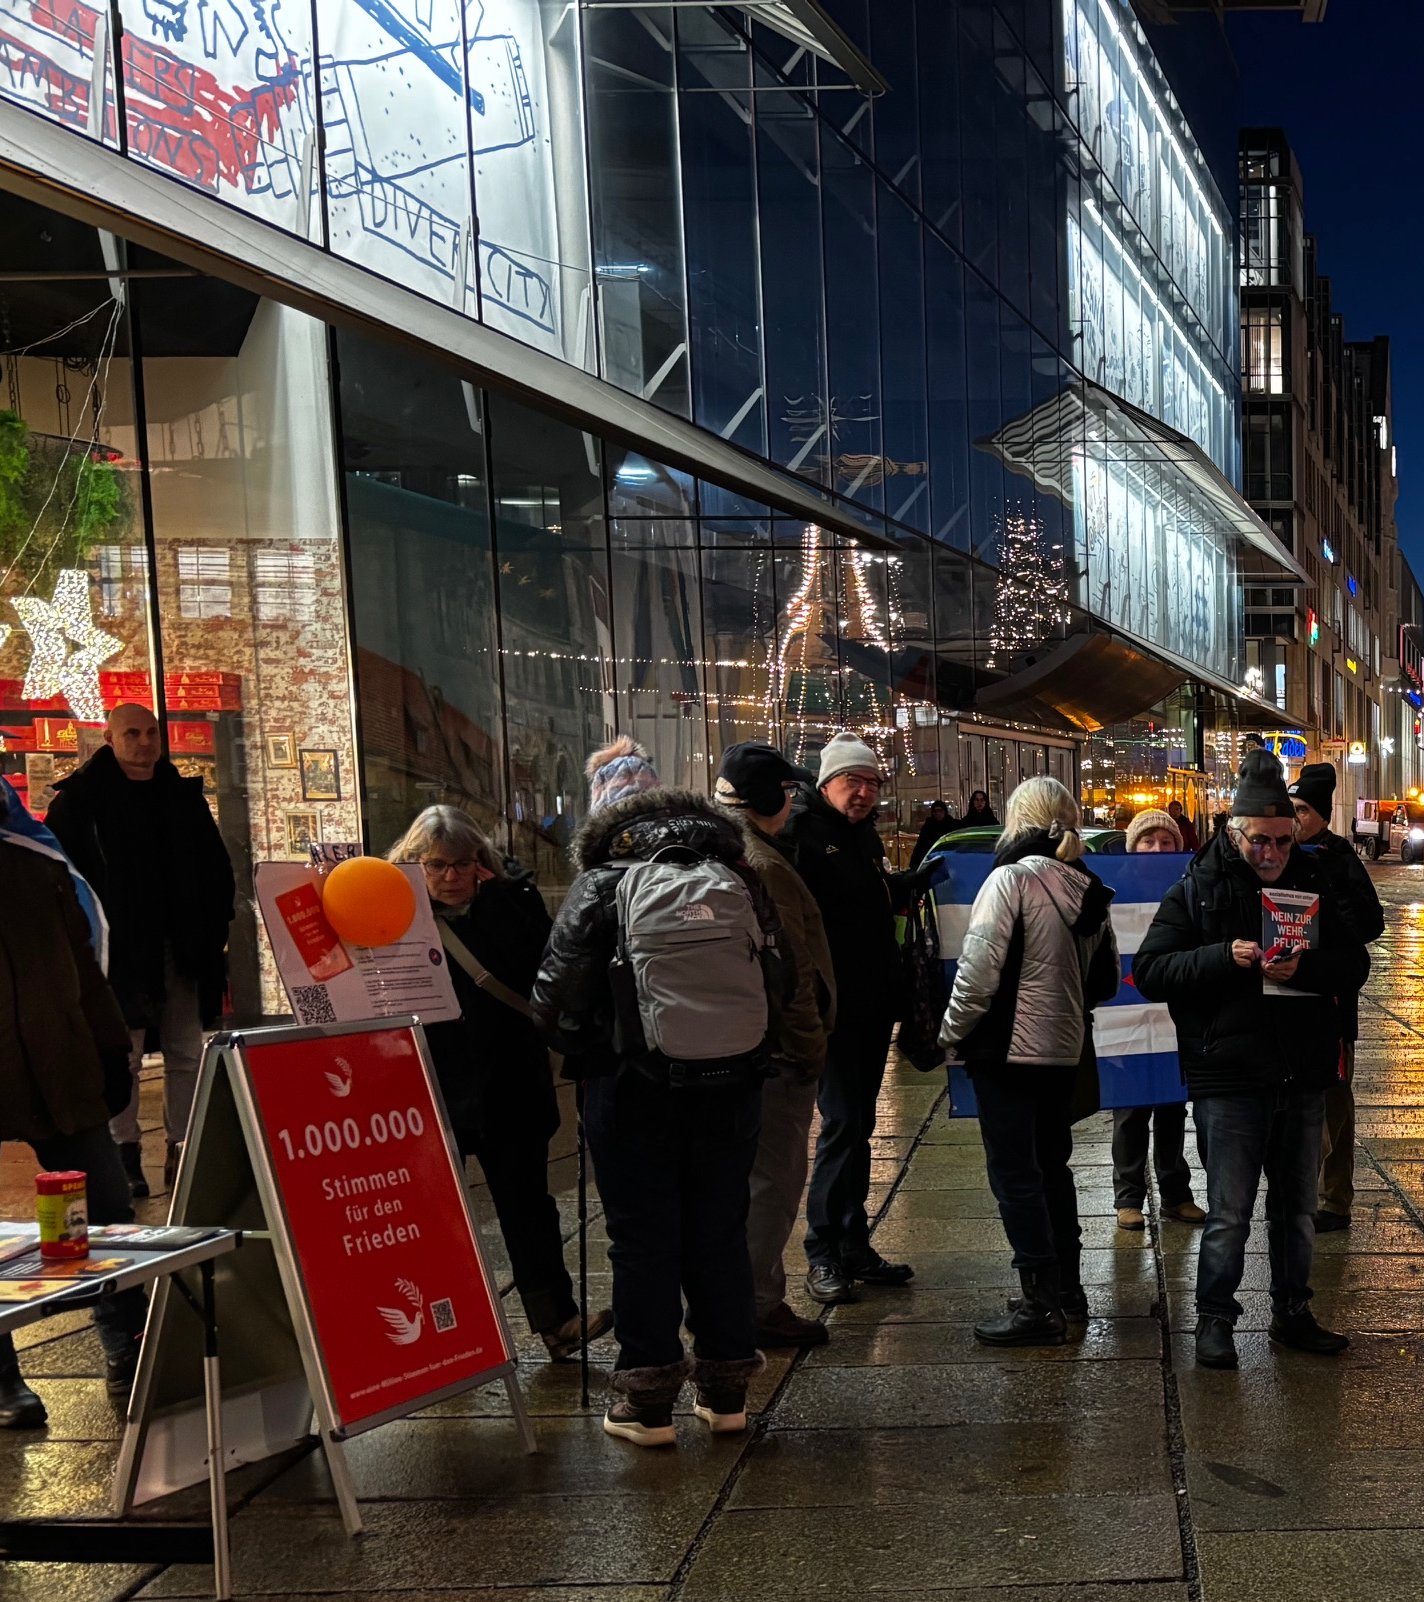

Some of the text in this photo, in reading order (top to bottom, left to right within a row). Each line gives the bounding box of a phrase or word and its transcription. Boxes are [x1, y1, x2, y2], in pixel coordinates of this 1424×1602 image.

[1271, 911, 1311, 925] NEIN ZUR
[1277, 924, 1308, 936] WEHR-
[1273, 937, 1310, 949] PFLICHT
[278, 1107, 424, 1161] 1.000.000
[322, 1167, 411, 1200] Stimmen
[345, 1199, 403, 1223] für den
[342, 1223, 421, 1256] Frieden
